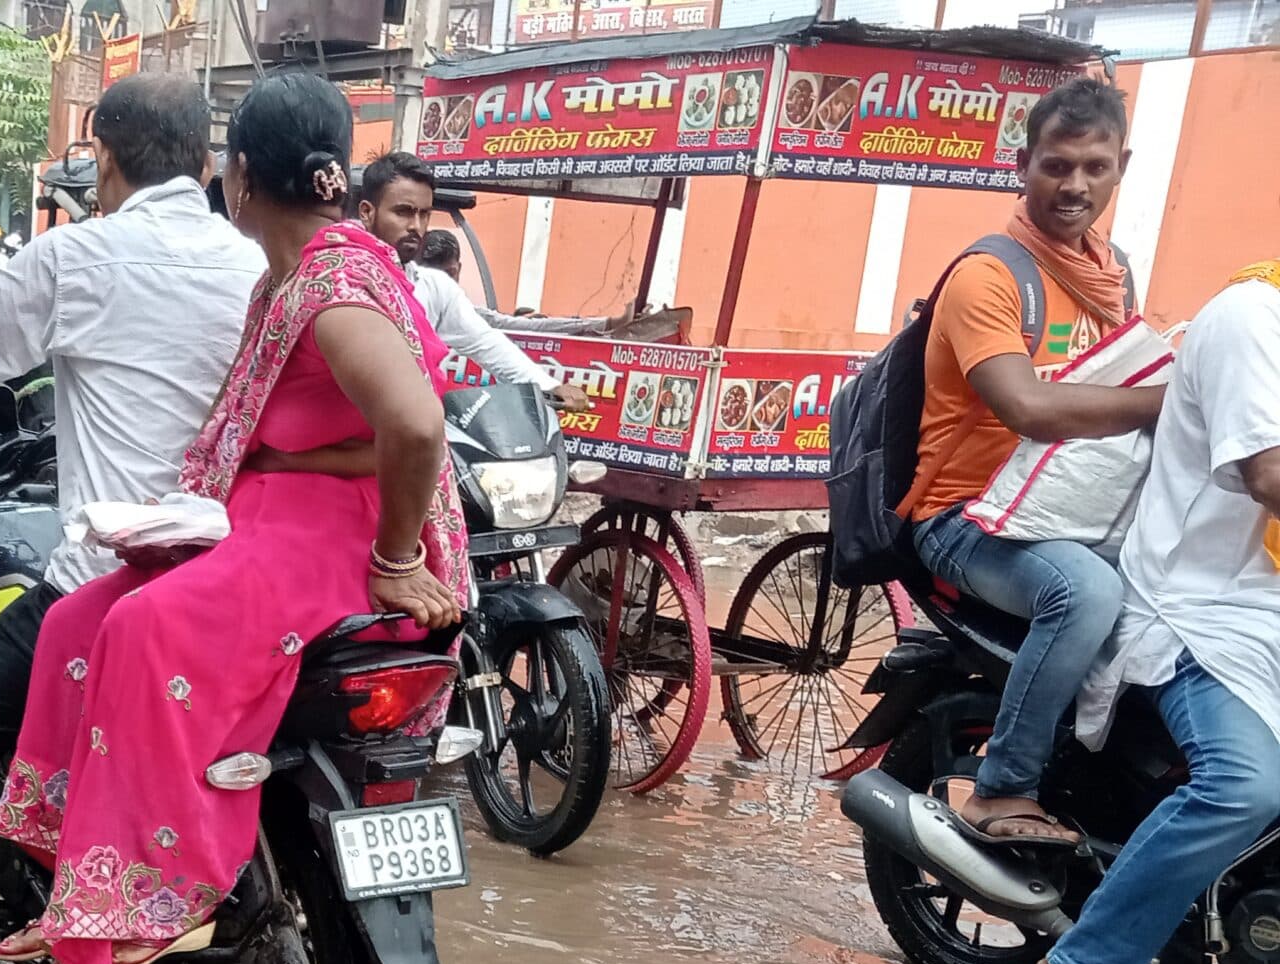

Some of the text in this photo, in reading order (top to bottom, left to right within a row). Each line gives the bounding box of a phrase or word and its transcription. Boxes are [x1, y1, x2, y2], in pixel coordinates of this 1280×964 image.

[474, 72, 680, 129] A.K मोमो
[860, 72, 1004, 122] A.K मोमो
[483, 126, 583, 156] दार्जिलिंग
[585, 124, 658, 149] फेमस
[859, 126, 936, 156] दार्जिलिंग
[937, 131, 985, 160] फेमस
[535, 158, 560, 176] किसी
[560, 157, 574, 174] भी
[574, 160, 597, 174] अन्य
[634, 159, 648, 173] पर
[678, 153, 705, 171] लिया
[706, 156, 734, 171] जाता
[793, 157, 816, 174] हमारे
[611, 346, 639, 366] Mob-
[580, 441, 594, 456] पर
[618, 445, 643, 464] लिया
[643, 452, 668, 469] जाता
[732, 456, 753, 472] हमारे
[363, 812, 448, 849] BR03A
[369, 845, 452, 883] P9368
